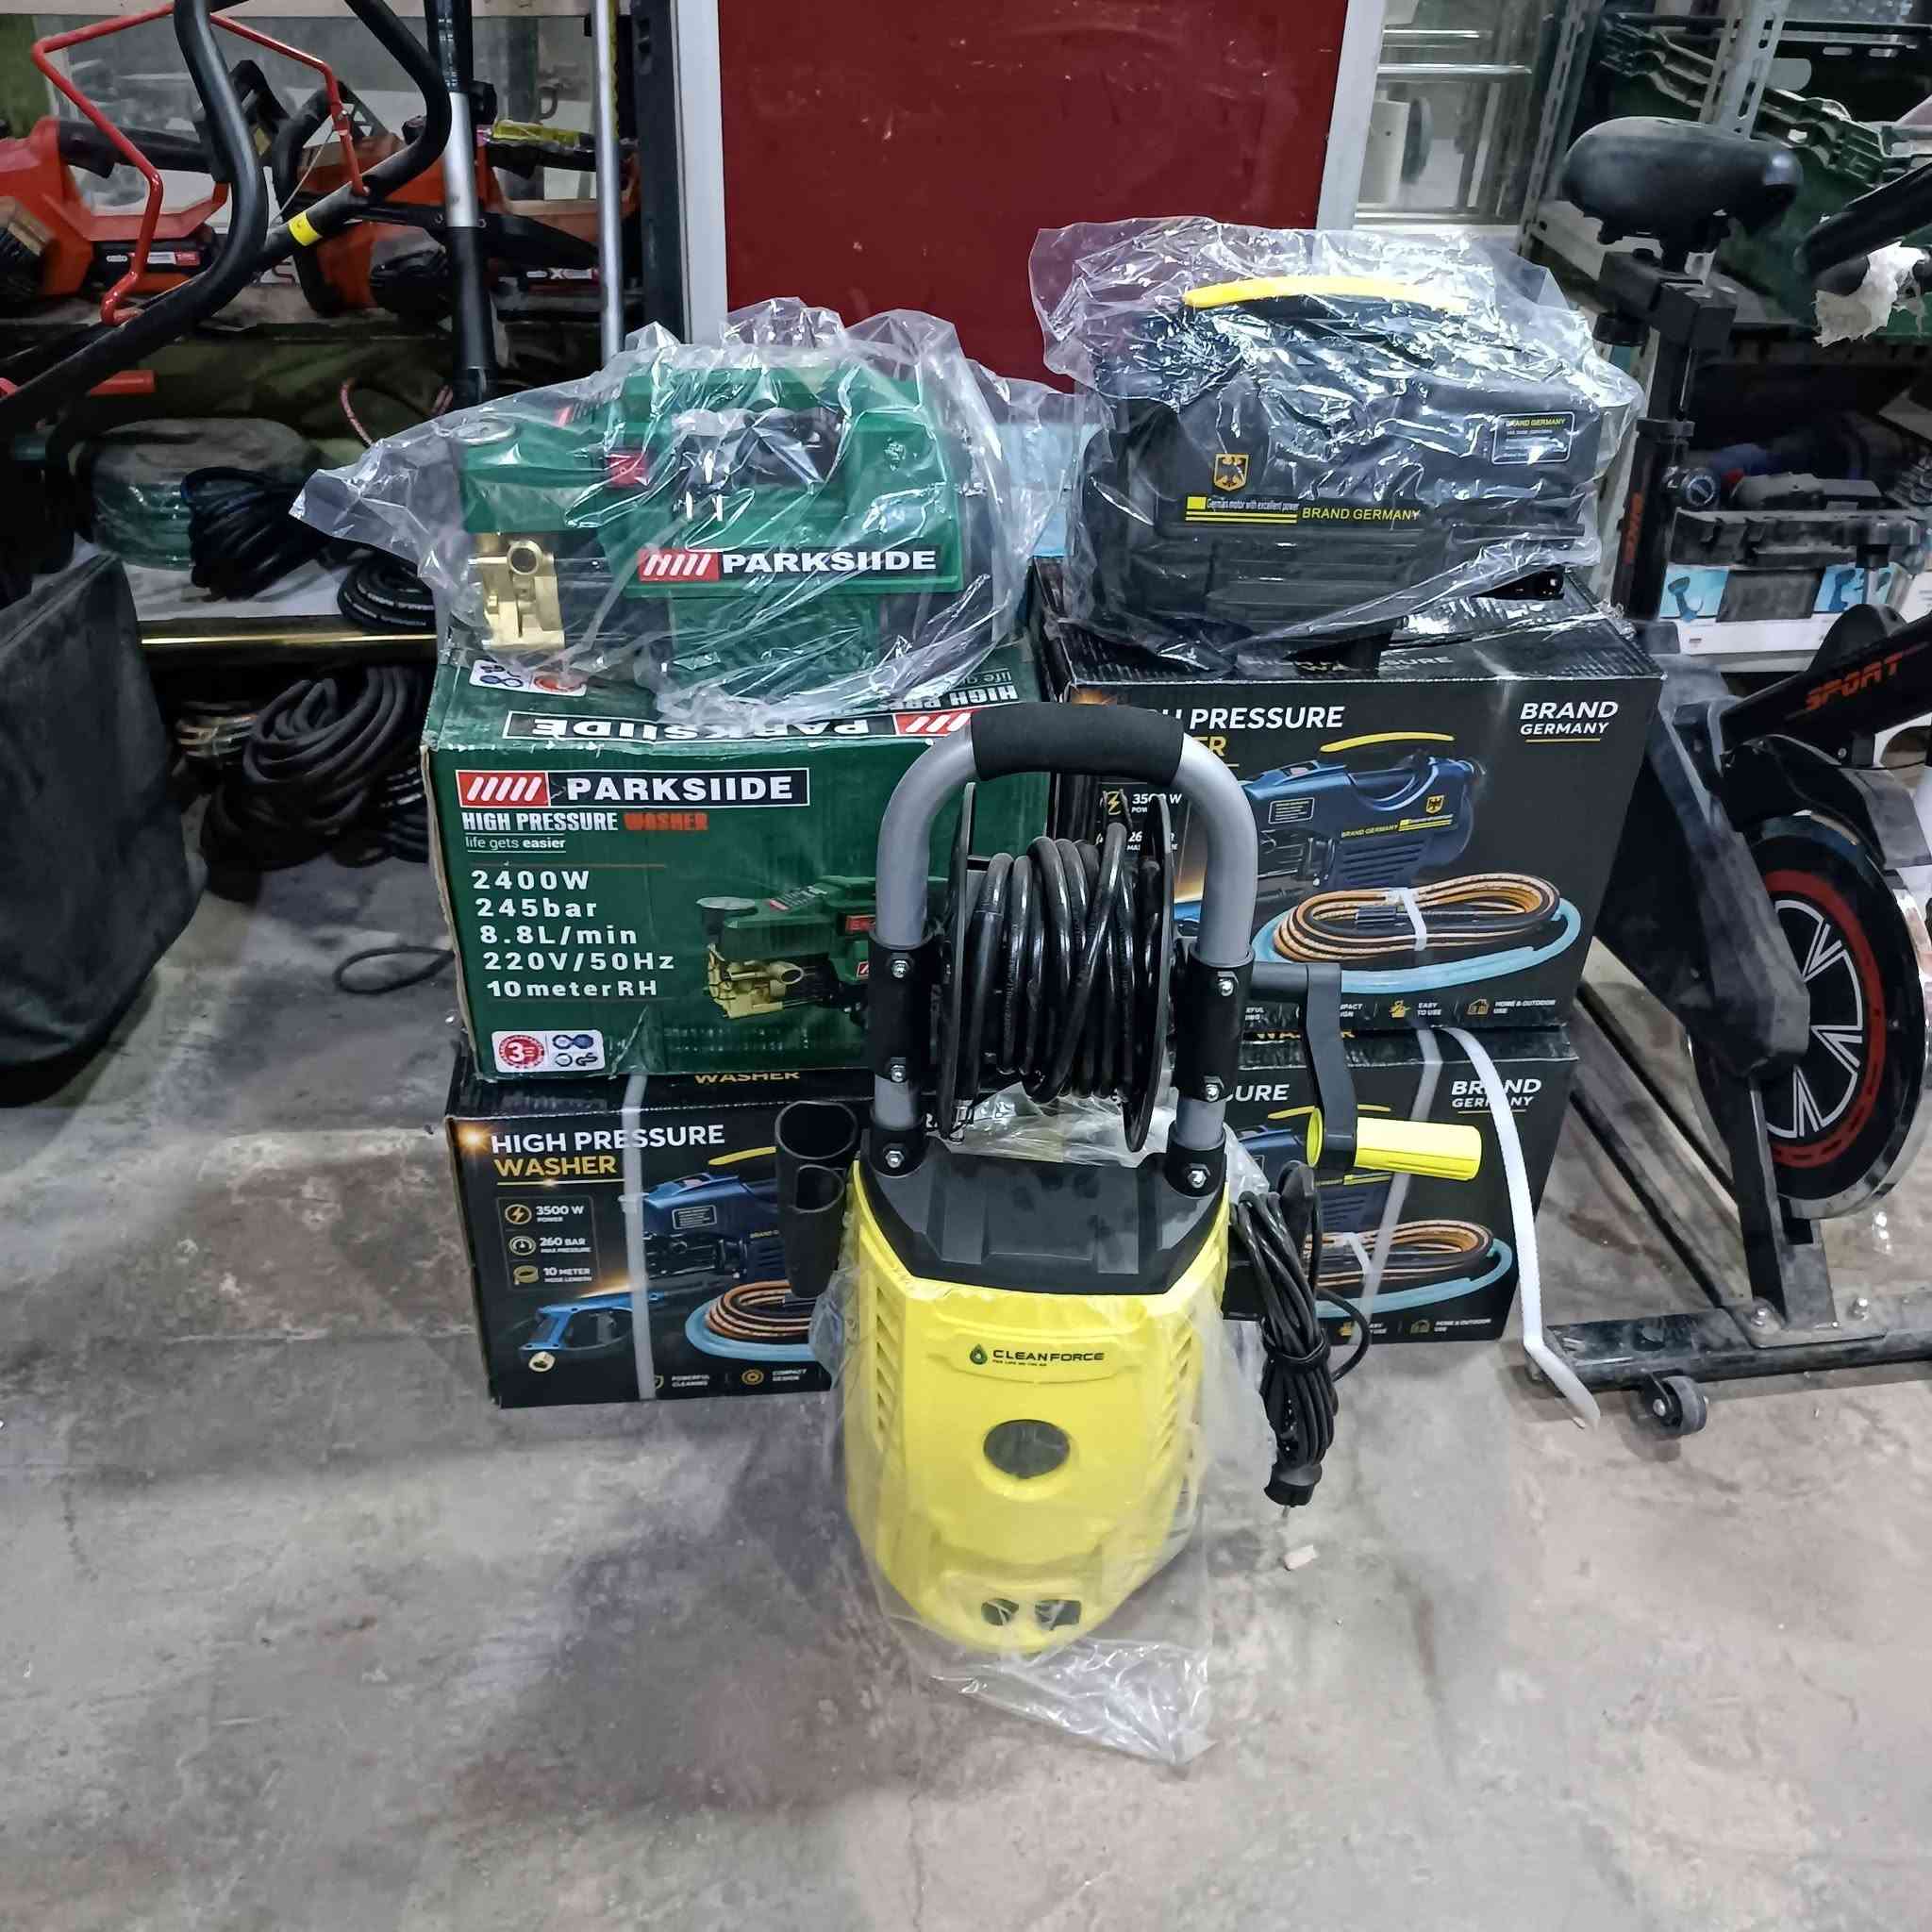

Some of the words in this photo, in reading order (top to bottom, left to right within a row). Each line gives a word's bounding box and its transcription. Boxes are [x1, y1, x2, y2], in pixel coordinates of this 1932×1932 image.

[1530, 418, 1566, 426] GERMANY
[1302, 508, 1350, 521] BRAND
[1353, 508, 1420, 521] GERMANY
[721, 550, 937, 575] PARKSIIDE
[982, 671, 1012, 683] life
[1806, 652, 1903, 710] SPORT
[949, 685, 1019, 707] HIGH
[1189, 706, 1346, 730] PRESSURE
[1519, 701, 1620, 721] BRAND
[1519, 722, 1610, 736] GERMANY
[567, 775, 793, 802] PARKSIIDE
[461, 812, 511, 831] HIGH
[516, 812, 619, 831] PRESSURE
[623, 812, 708, 831] WASHER
[465, 836, 487, 849] life
[490, 838, 520, 852] gets
[522, 837, 567, 850] easier
[1128, 831, 1143, 842] 26
[472, 870, 590, 891] 2400W
[475, 897, 597, 918] 245bar
[479, 924, 638, 945] 8.8L/min
[483, 951, 675, 972] 220V/50Hz
[1451, 1078, 1542, 1095] BRND
[1451, 1095, 1535, 1108] GERNY
[491, 1133, 566, 1155] HIGH
[575, 1124, 725, 1151] PRESSURE
[493, 1155, 618, 1177] WASHER
[535, 1206, 570, 1216] 3500
[571, 1206, 585, 1215] W
[540, 1237, 563, 1246] 260
[564, 1238, 586, 1246] BAR
[542, 1267, 558, 1276] 10
[558, 1267, 591, 1275] METER
[992, 1349, 1106, 1361] CLEANFORCE
